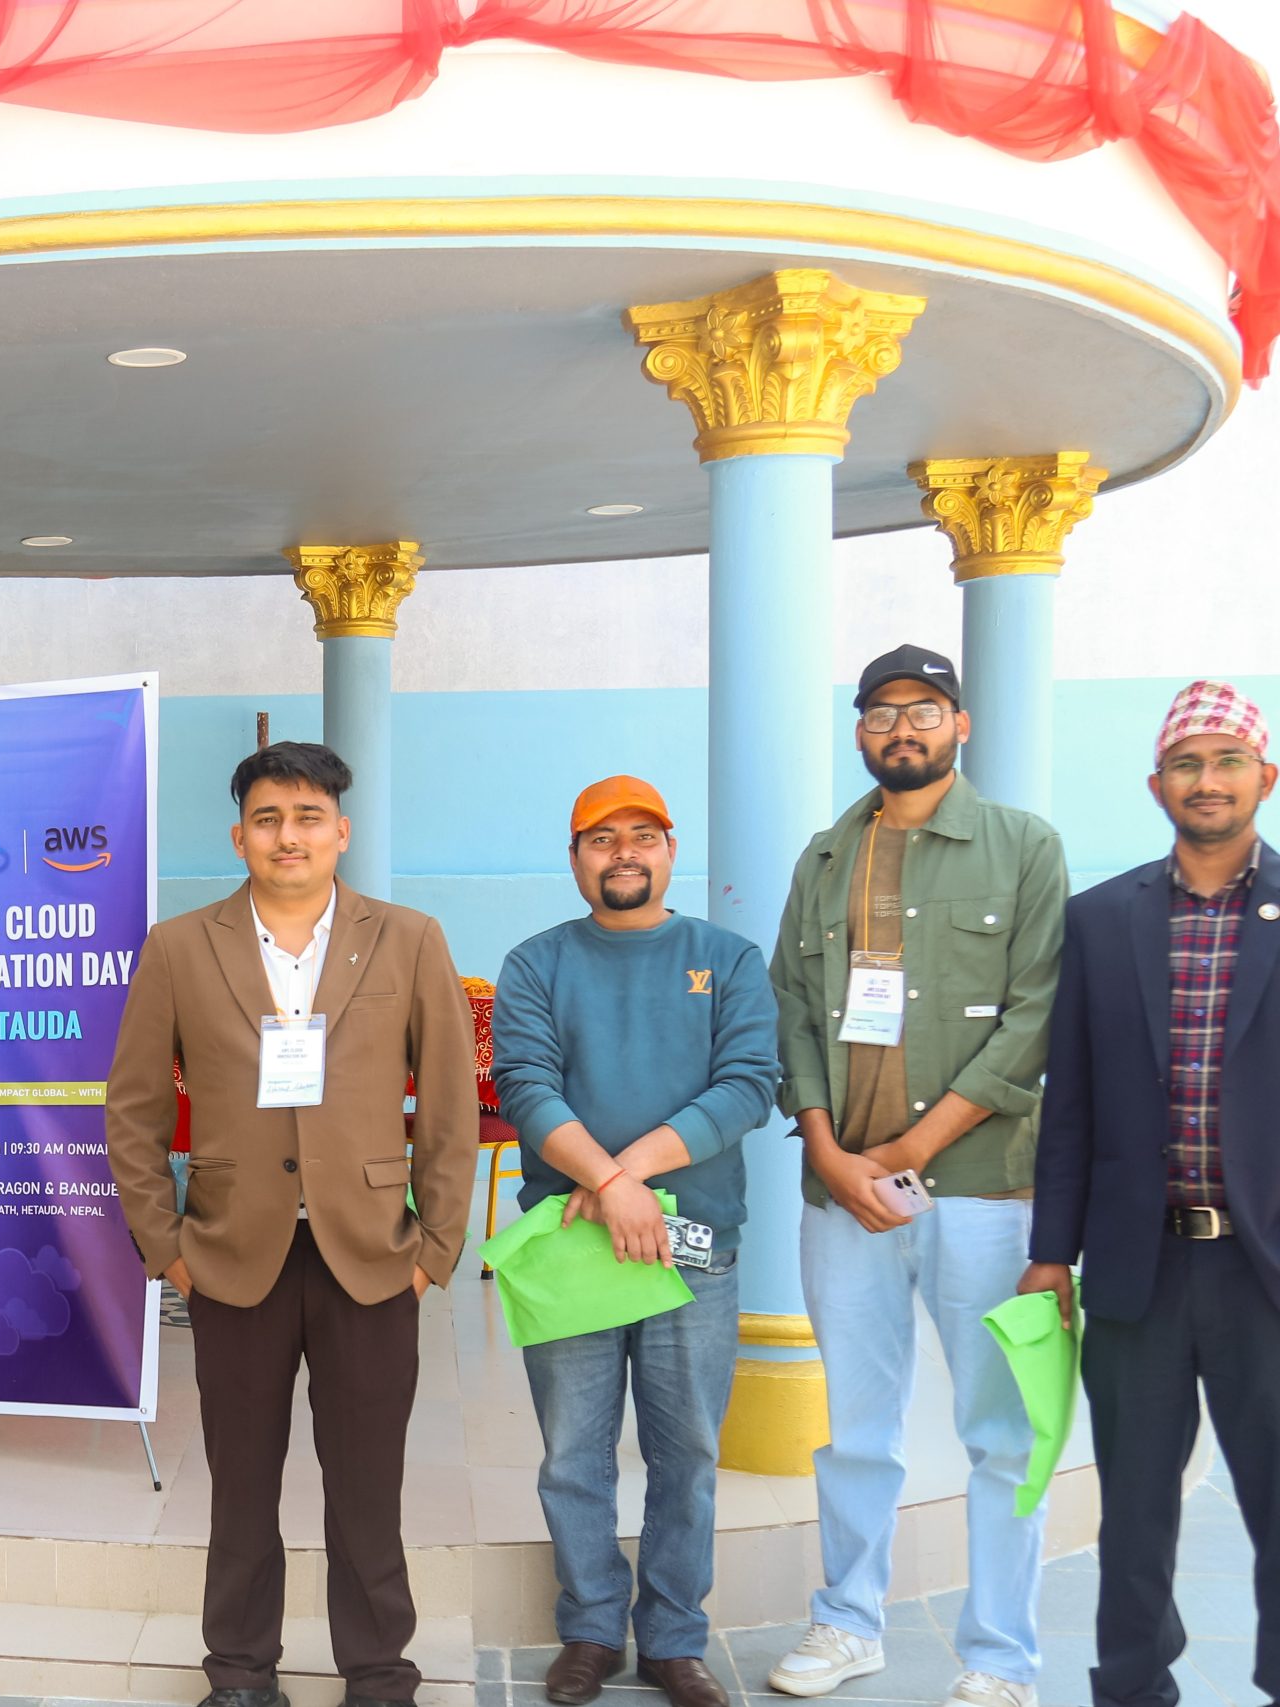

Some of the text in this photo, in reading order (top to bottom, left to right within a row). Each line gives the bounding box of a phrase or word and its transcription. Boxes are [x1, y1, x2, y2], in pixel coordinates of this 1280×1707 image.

[45, 825, 108, 851] aws
[6, 903, 96, 941] CLOUD
[82, 950, 134, 986] DAY
[32, 1088, 68, 1097] GLOBAL
[79, 1088, 102, 1097] WITH
[10, 1143, 40, 1155] 09:30
[44, 1143, 64, 1155] AM
[67, 1143, 108, 1155] ONWA
[44, 1182, 54, 1195] &
[21, 1205, 67, 1217] HETAUDA,
[70, 1206, 105, 1217] NEPAL
